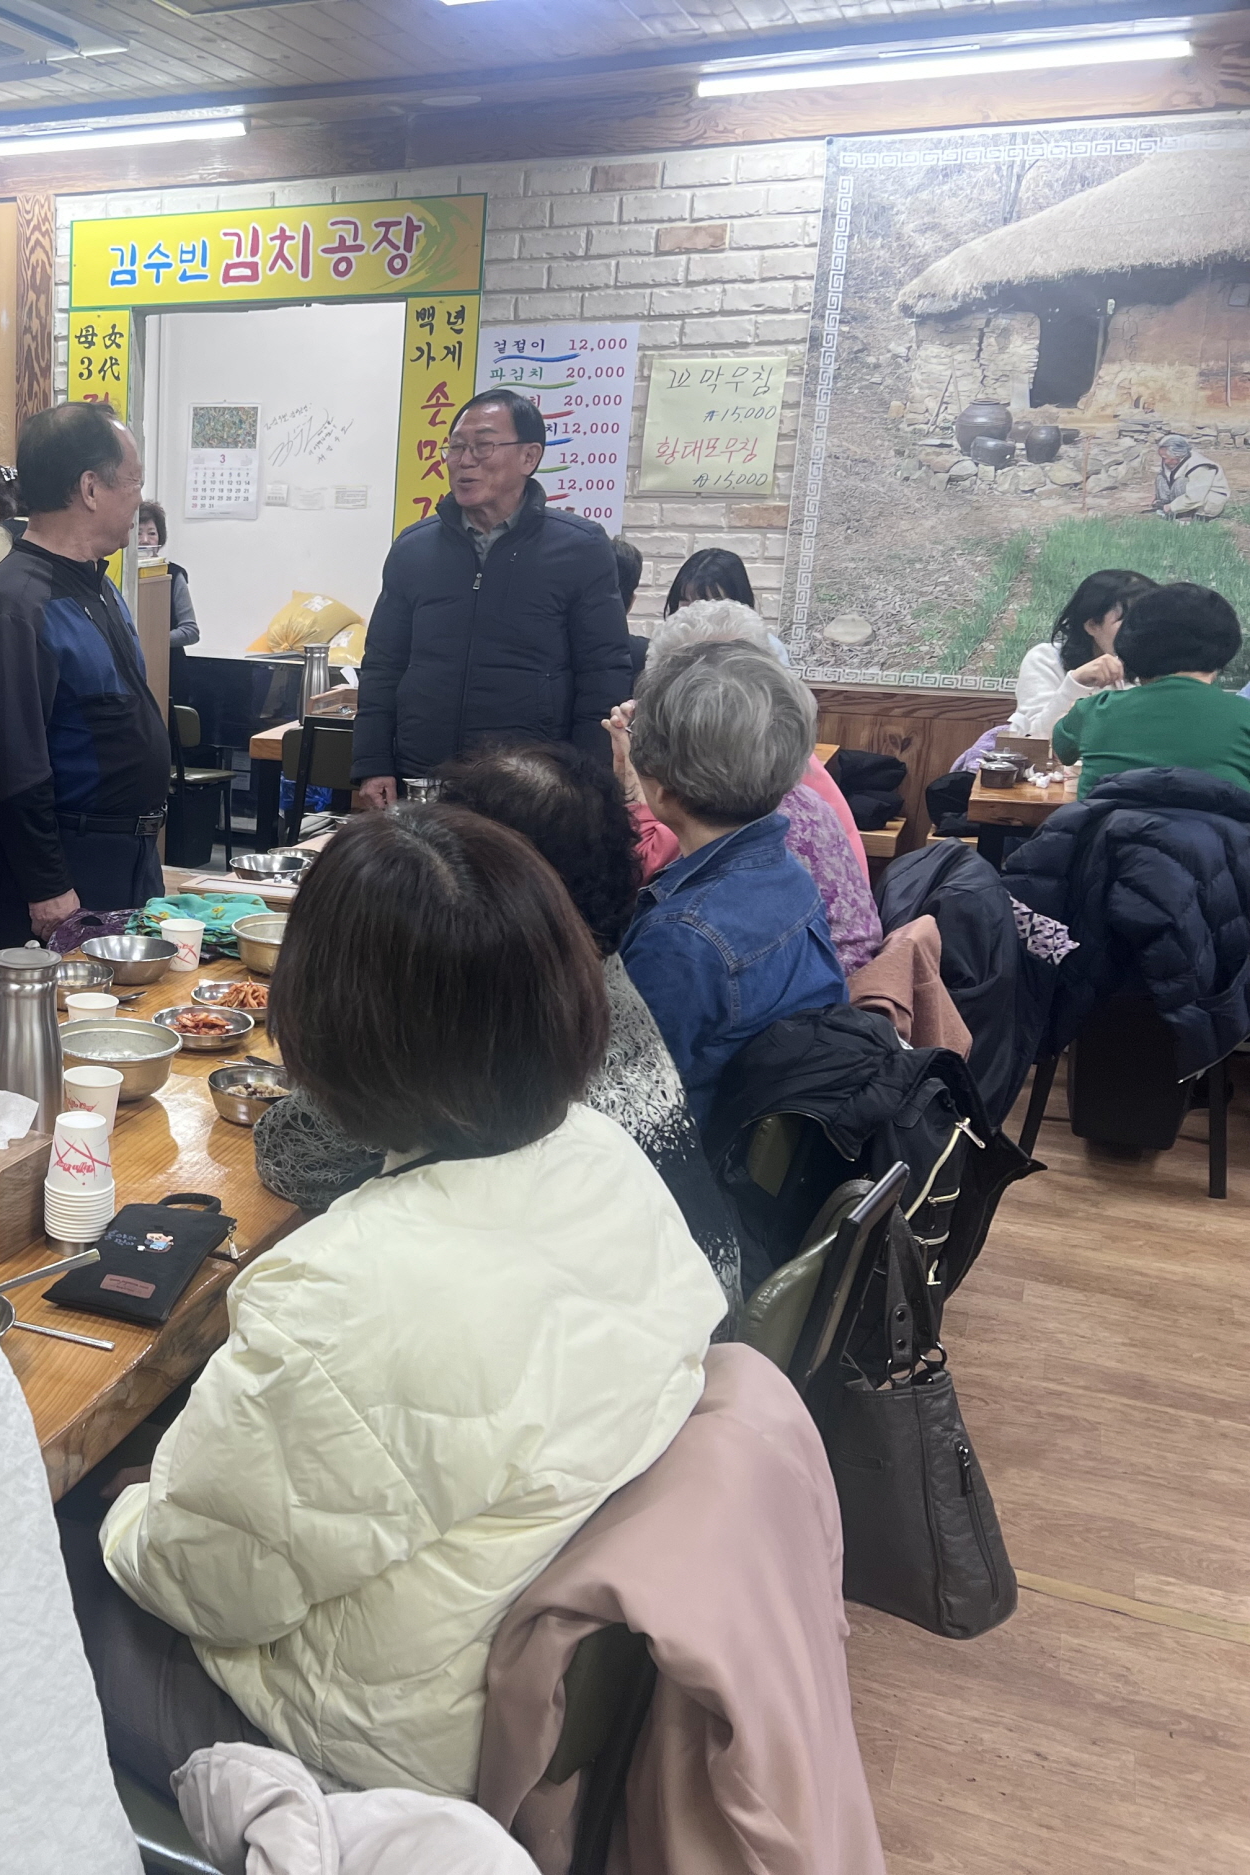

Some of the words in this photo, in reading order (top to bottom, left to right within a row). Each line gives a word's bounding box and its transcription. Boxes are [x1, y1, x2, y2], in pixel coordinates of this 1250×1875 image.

[109, 238, 210, 287] 김수빈
[219, 213, 424, 287] 김치공장
[74, 323, 124, 350] 母女
[494, 338, 545, 353] 겉절이
[568, 338, 628, 351] 12,000
[410, 341, 463, 371] 가게
[490, 367, 543, 381] 파김치
[566, 366, 625, 380] 20,000
[667, 364, 774, 397] 꼬막무침
[564, 395, 622, 408] 20,000
[561, 422, 620, 435] 12,000
[220, 454, 226, 463] 3
[656, 436, 758, 466] 황태포무침
[559, 452, 618, 466] 12,000
[557, 478, 615, 491] 12,000
